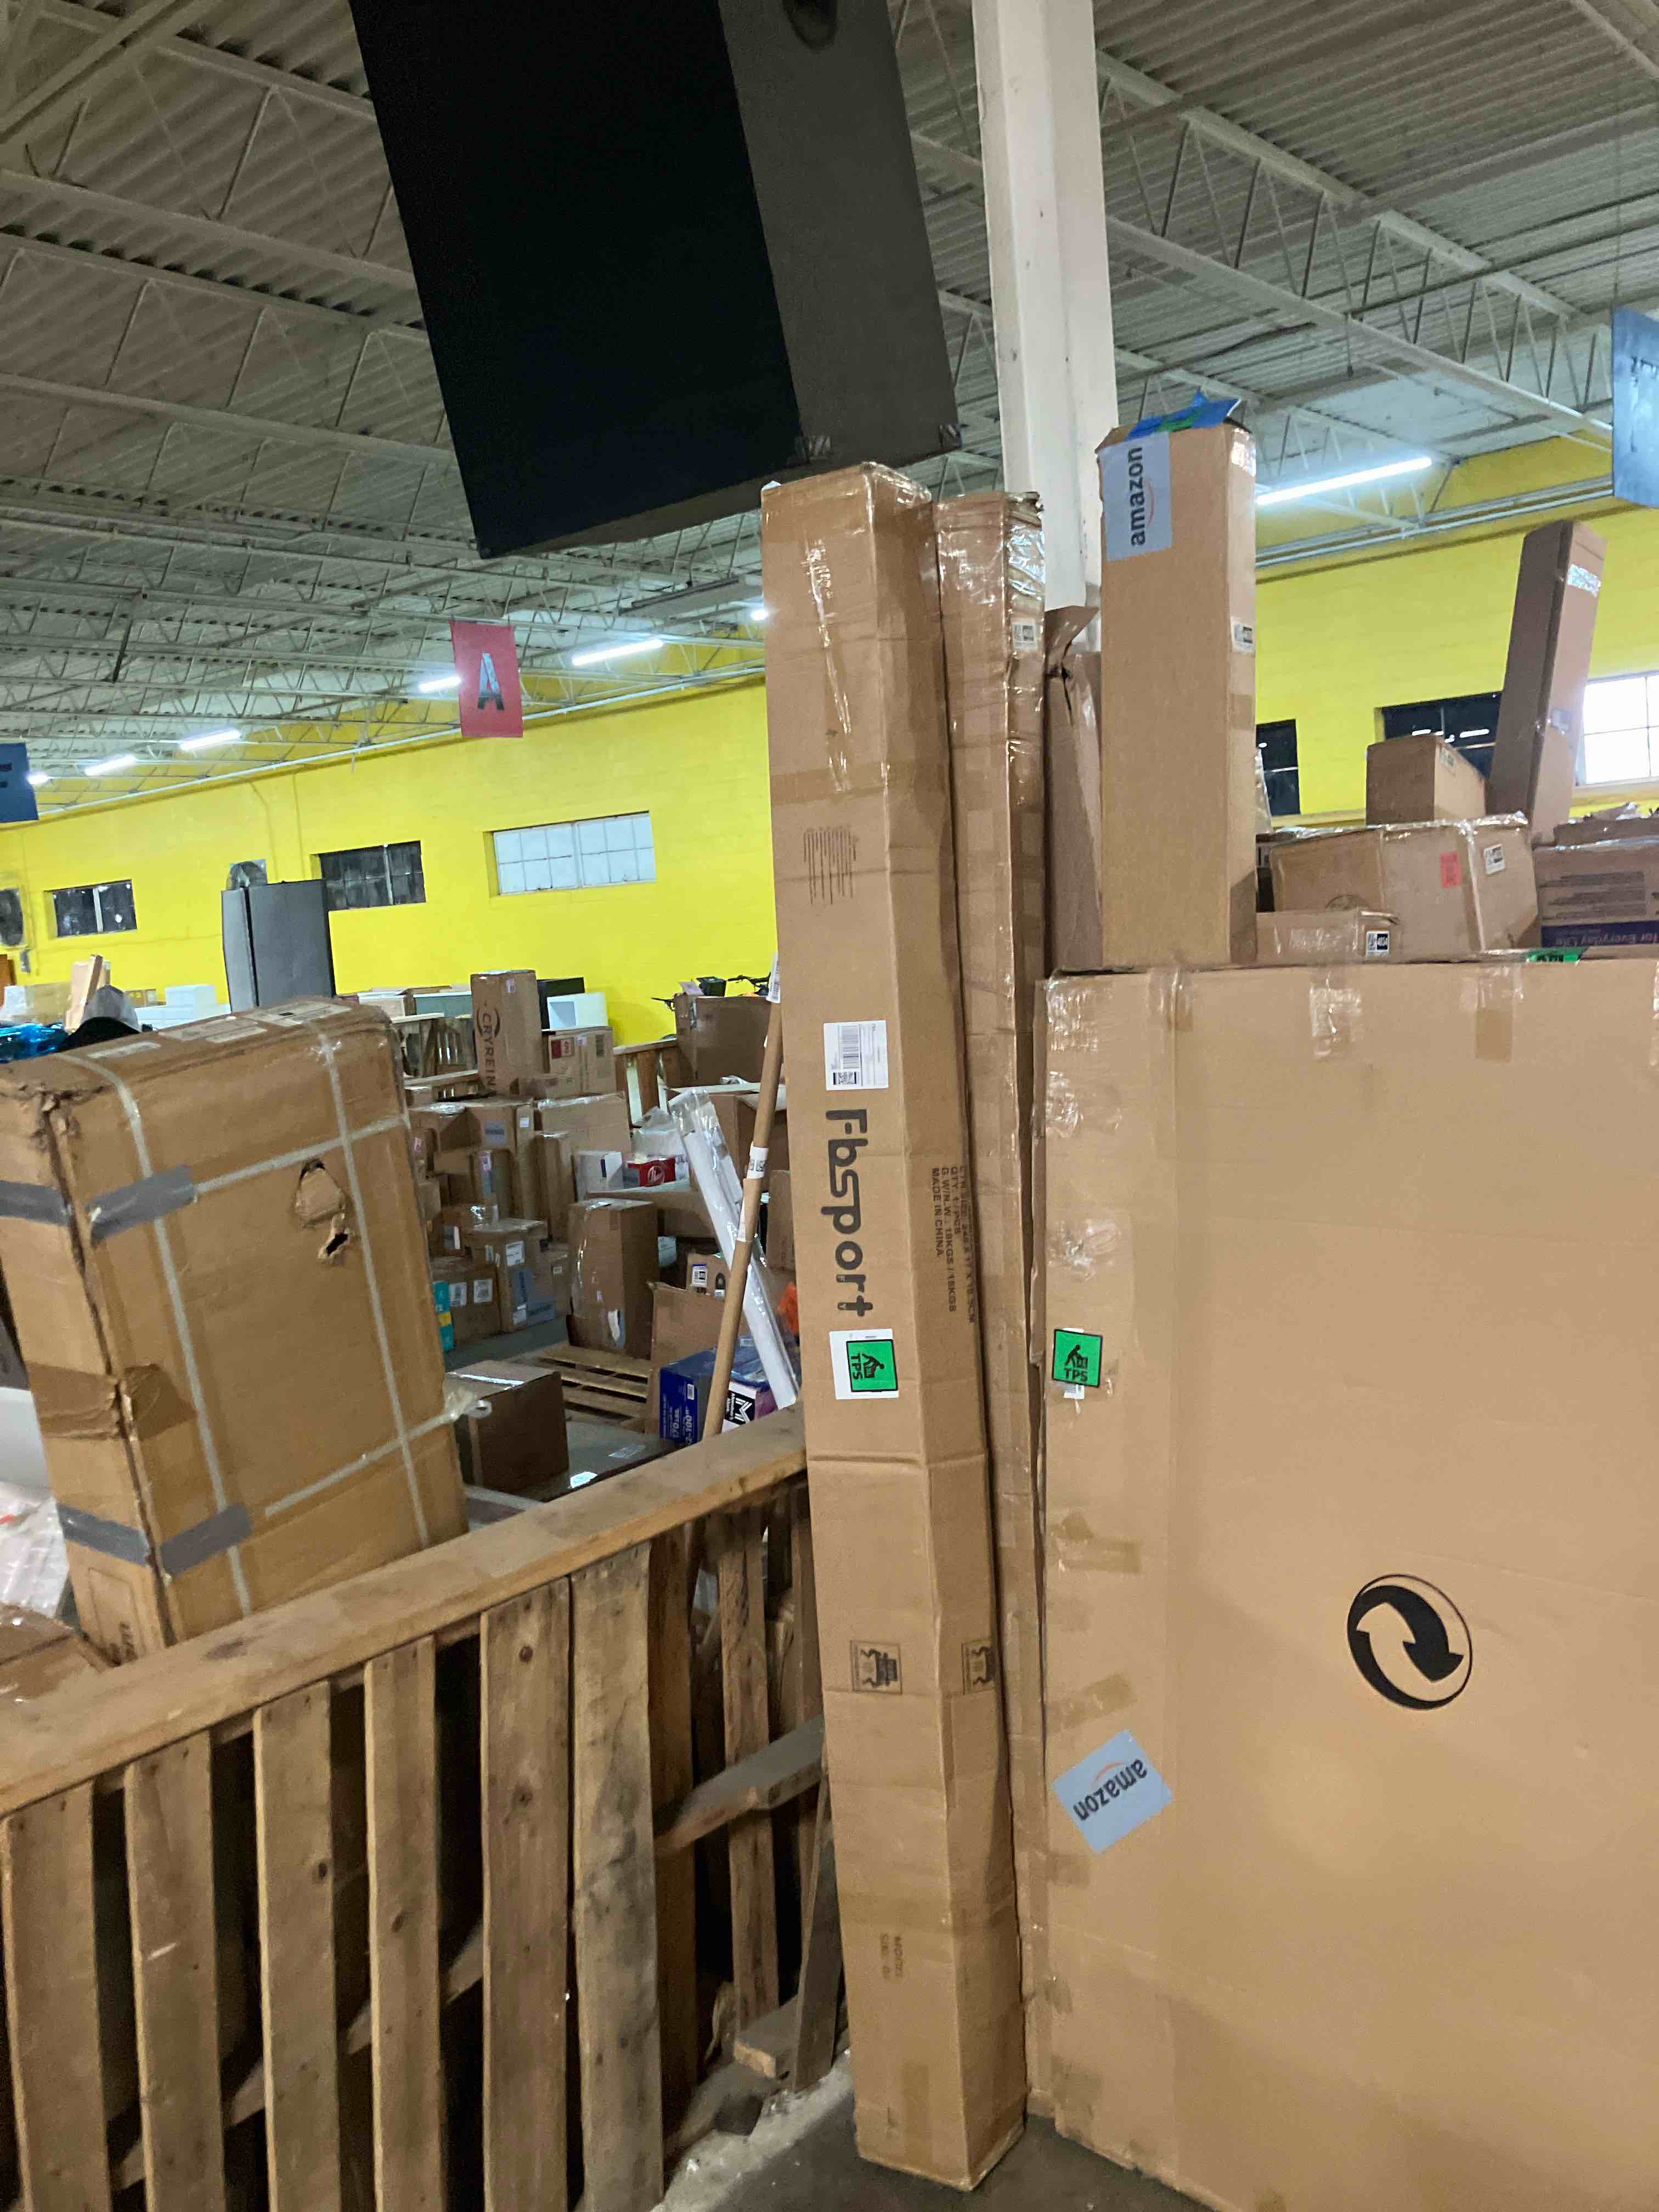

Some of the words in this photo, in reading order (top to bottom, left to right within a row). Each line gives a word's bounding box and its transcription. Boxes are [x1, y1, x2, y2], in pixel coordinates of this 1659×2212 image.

[1128, 447, 1146, 546] amazon
[477, 652, 505, 711] A
[932, 1167, 941, 1202] MADE
[821, 1109, 873, 1317] Fbsport
[934, 1204, 943, 1216] IN
[935, 1220, 944, 1256] CHINA
[850, 1353, 864, 1380] TPS
[1064, 1367, 1088, 1382] TPS
[1073, 1758, 1148, 1821] amazon
